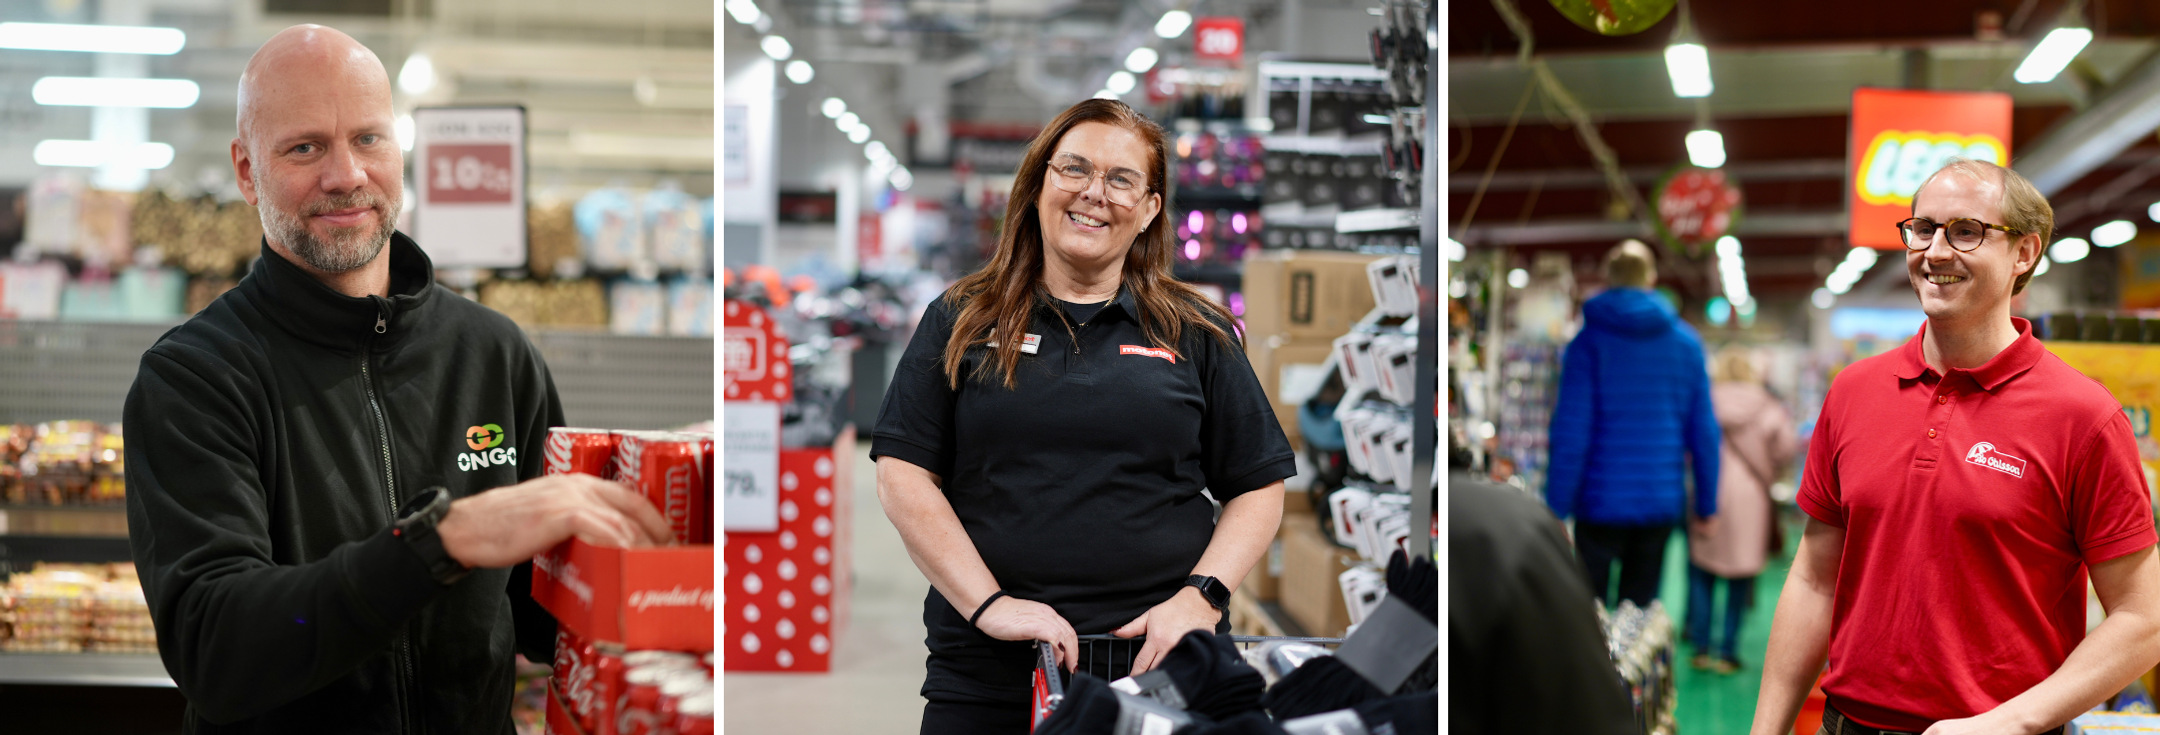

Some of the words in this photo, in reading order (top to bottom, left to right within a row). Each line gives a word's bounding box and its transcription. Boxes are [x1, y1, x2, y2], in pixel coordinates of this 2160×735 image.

[1122, 347, 1173, 361] motonet
[457, 446, 517, 472] ONGO
[1987, 456, 2021, 476] Ohlsson
